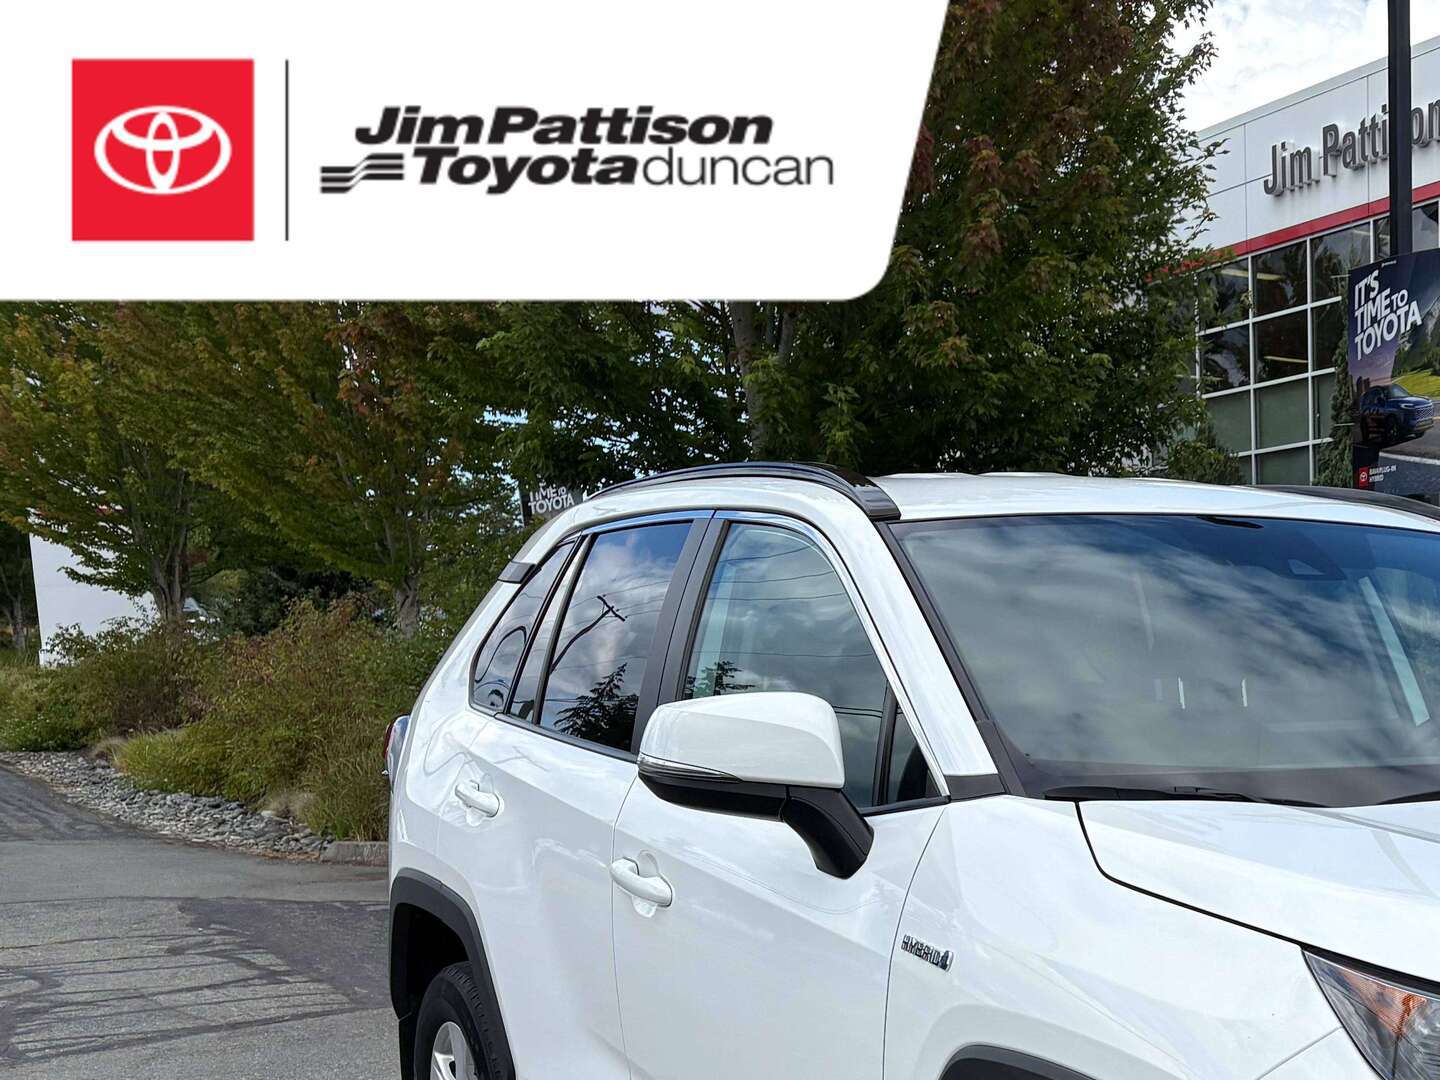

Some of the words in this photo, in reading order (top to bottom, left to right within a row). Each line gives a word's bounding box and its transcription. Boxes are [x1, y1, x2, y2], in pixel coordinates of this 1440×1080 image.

[1263, 140, 1316, 197] Jim
[1354, 268, 1380, 311] IT'S
[1354, 287, 1392, 334] TIME
[1391, 288, 1409, 312] TO
[1354, 299, 1423, 361] TOYOTA
[528, 493, 575, 515] TOYOTA
